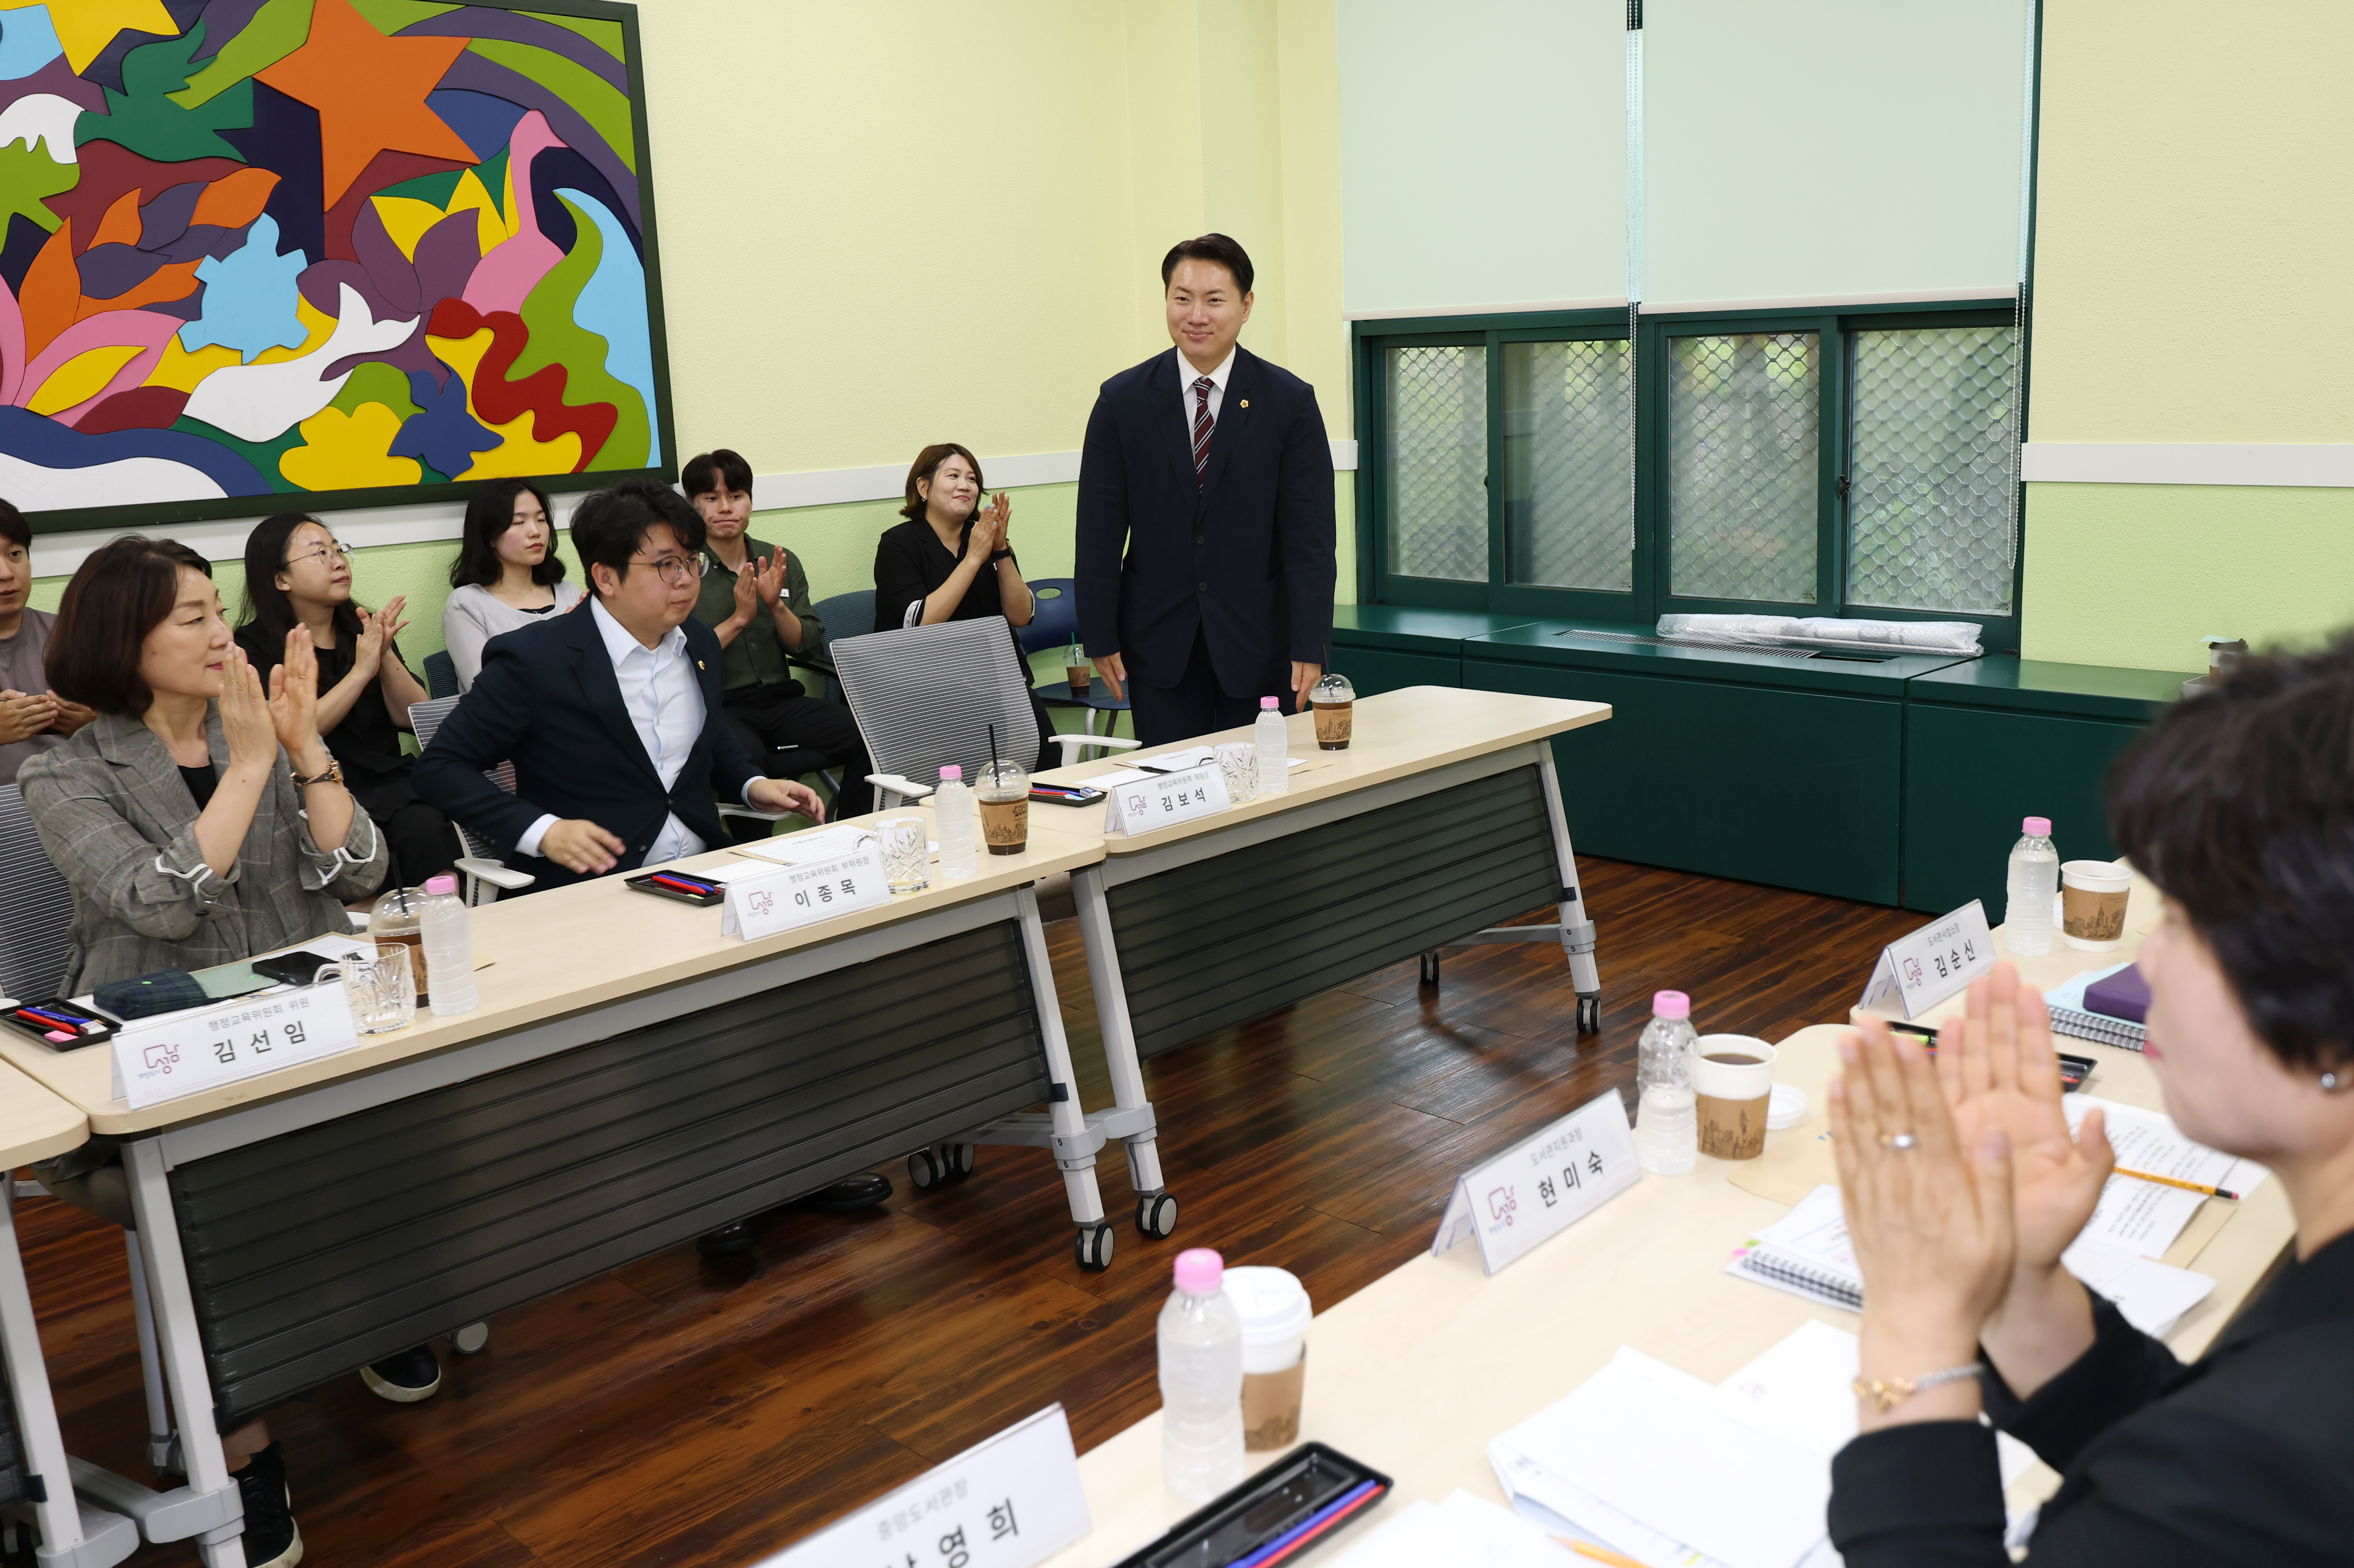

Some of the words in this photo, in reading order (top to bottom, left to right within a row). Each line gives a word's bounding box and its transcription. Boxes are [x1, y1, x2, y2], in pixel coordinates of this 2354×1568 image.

[1157, 775, 1192, 790] 행정교육위원회
[1194, 771, 1209, 780] 위원장
[1161, 787, 1205, 812] 김보석
[789, 864, 838, 883] 행정교육위원회
[842, 856, 869, 869] 부위원장
[795, 879, 856, 907] 이종목
[1928, 922, 1959, 946] 도서관사업소장
[1934, 939, 1975, 978] 김순신
[208, 1004, 283, 1031] 행정교육위원회
[289, 997, 310, 1010] 위원
[213, 1021, 306, 1064] 김선임
[1531, 1127, 1583, 1166] 도서관지원과장
[1538, 1151, 1604, 1208] 현미숙
